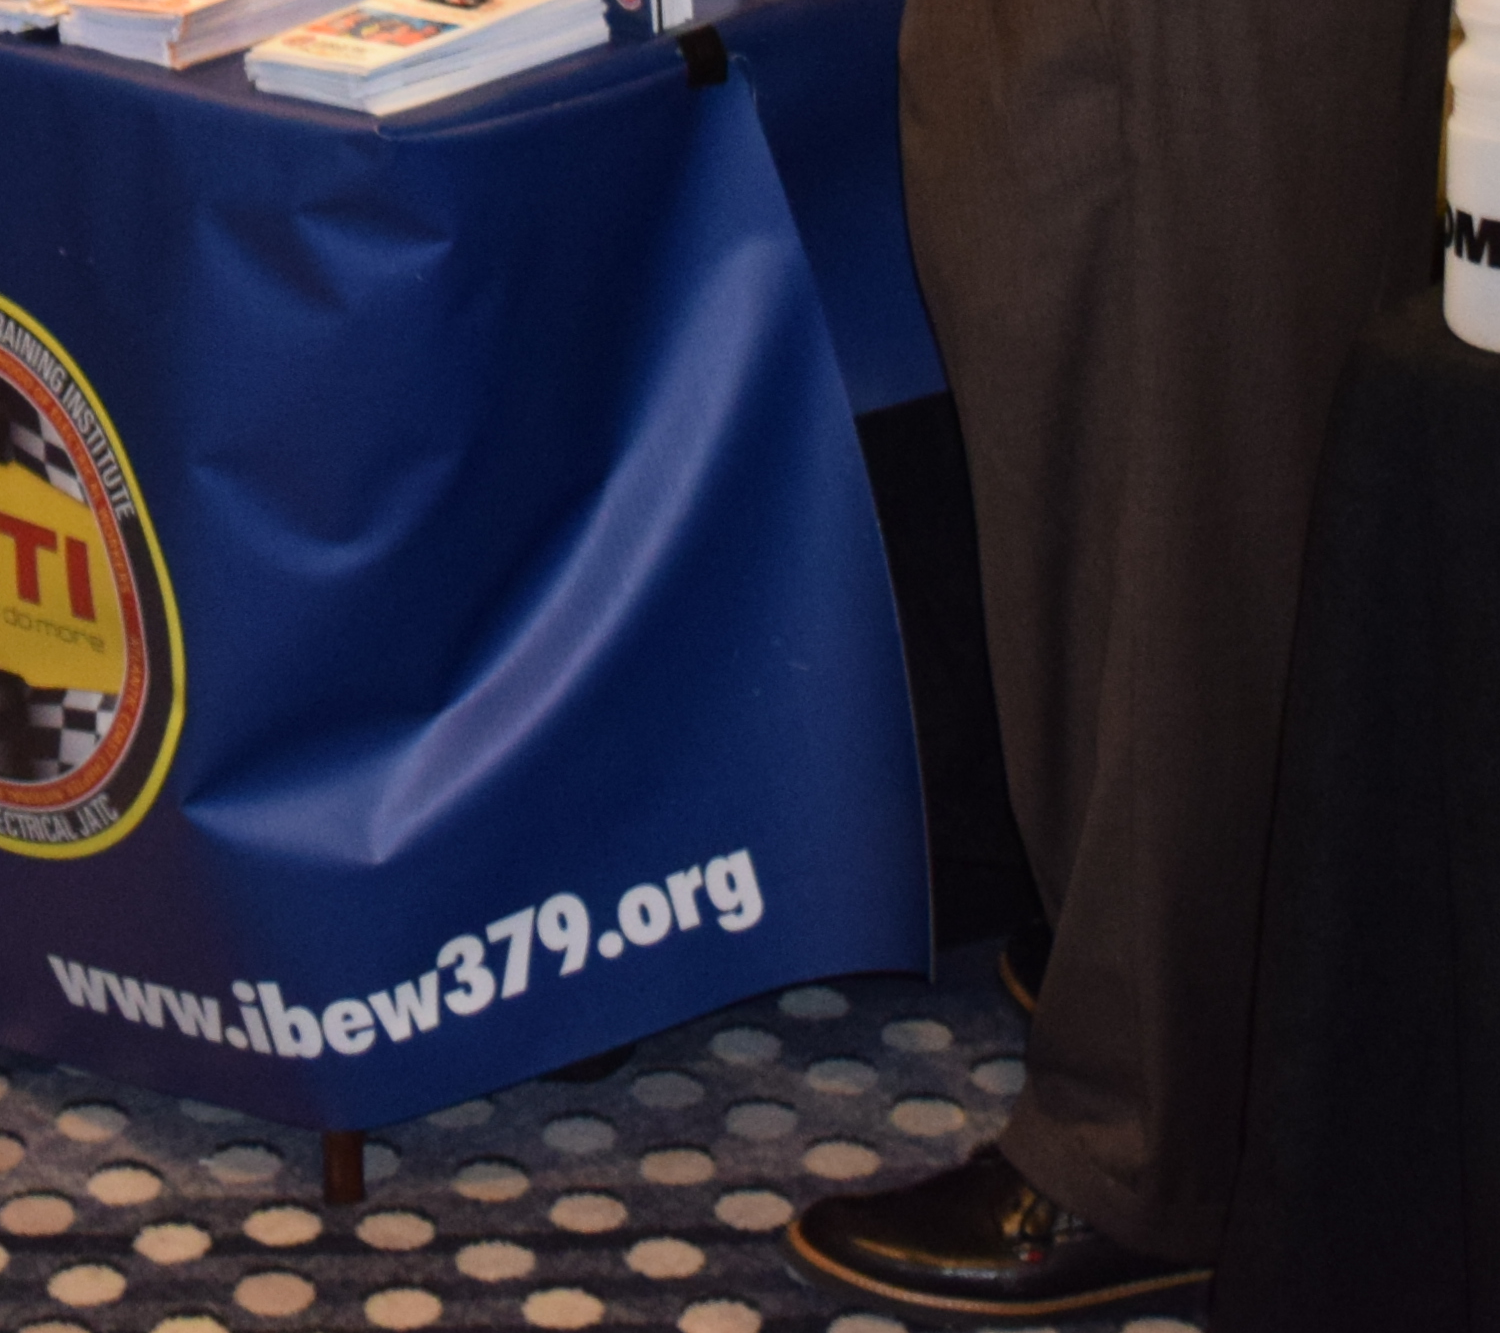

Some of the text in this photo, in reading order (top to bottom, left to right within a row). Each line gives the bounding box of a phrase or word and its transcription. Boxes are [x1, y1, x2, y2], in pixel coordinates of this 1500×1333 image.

[58, 383, 138, 523] INSTITUTE
[1, 601, 34, 633] do
[36, 618, 106, 655] more
[77, 791, 121, 842] JATC
[47, 848, 767, 1060] www.ibew379.org
